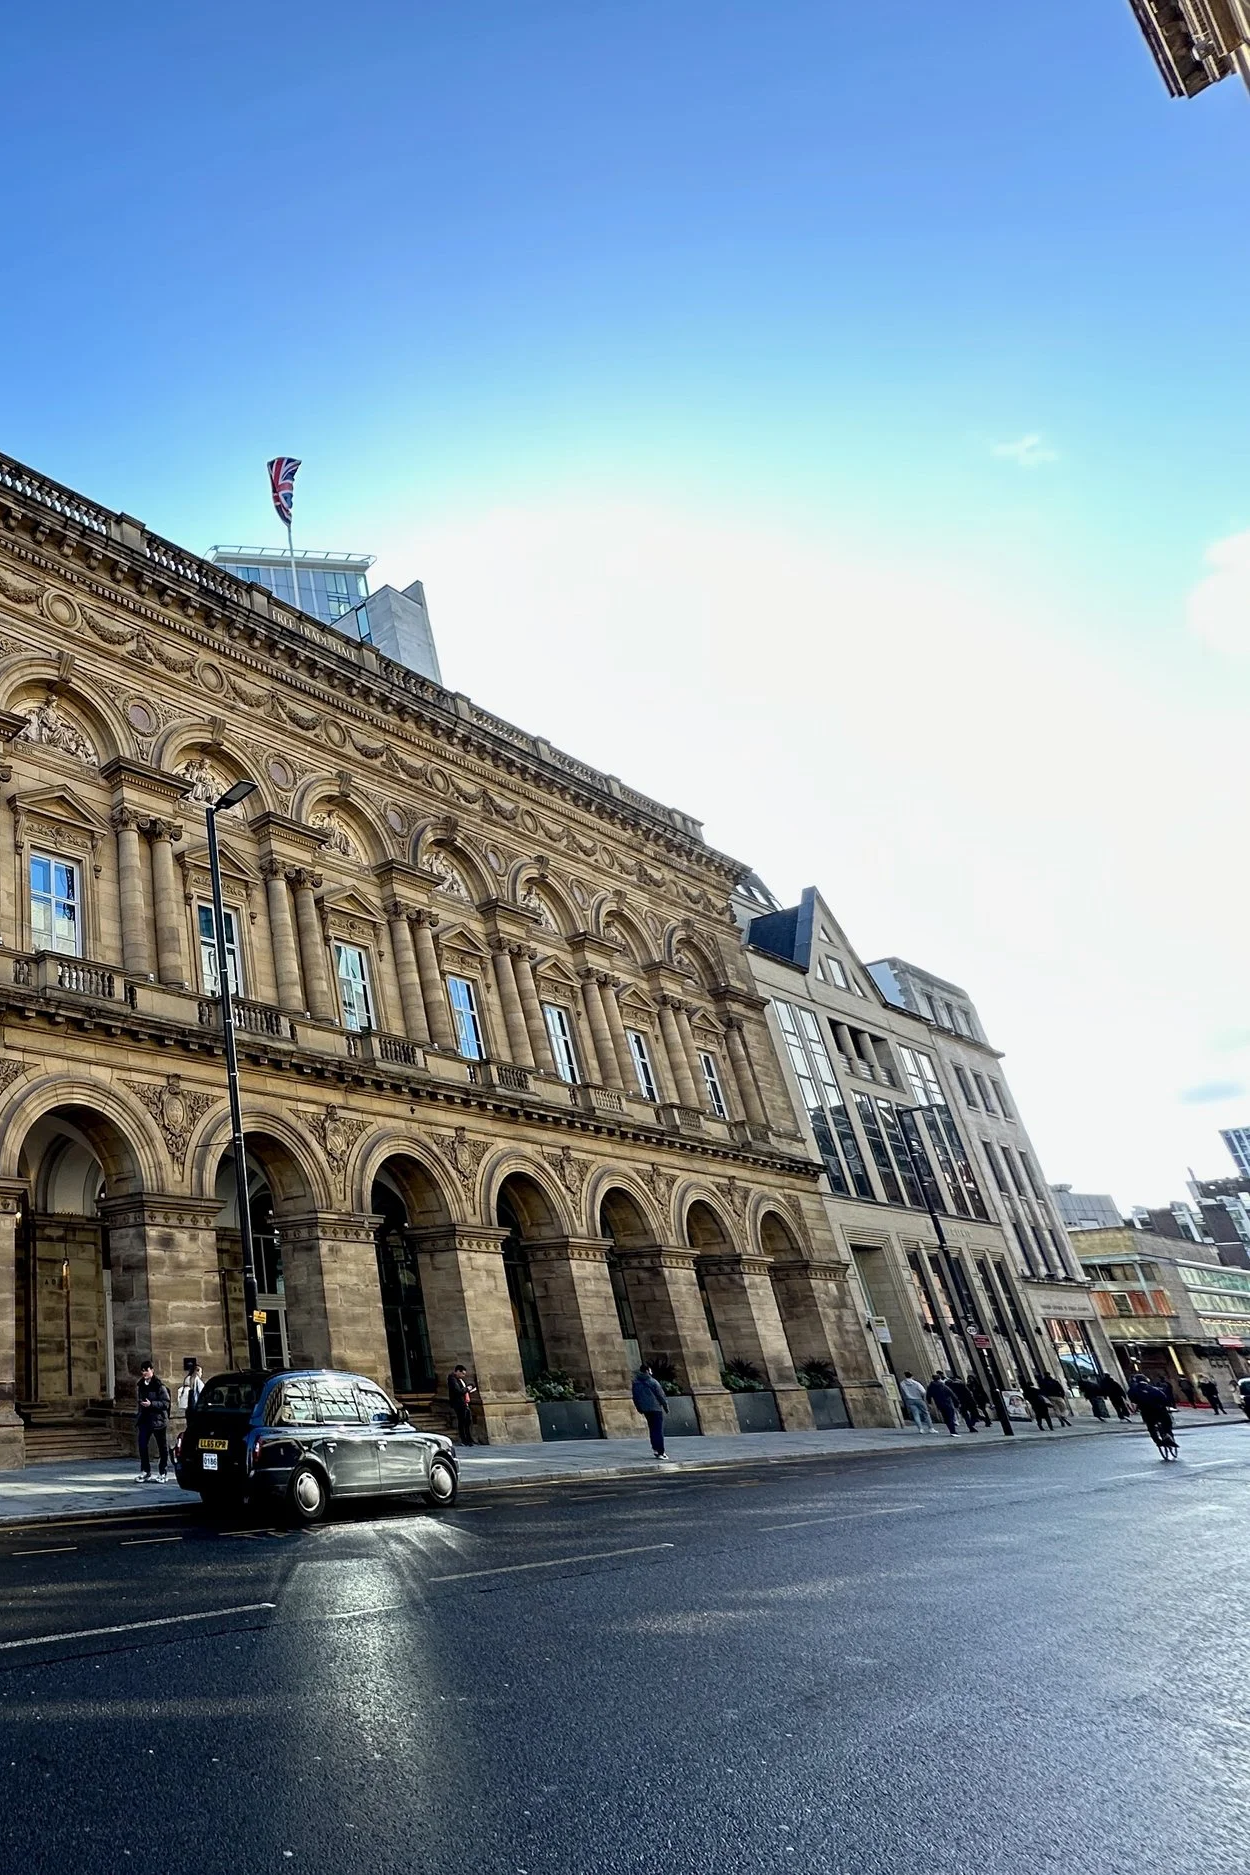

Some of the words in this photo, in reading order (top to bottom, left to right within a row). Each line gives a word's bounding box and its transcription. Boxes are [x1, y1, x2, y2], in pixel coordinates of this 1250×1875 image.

[272, 610, 295, 629] FREE
[300, 625, 330, 648] TRADE
[332, 641, 357, 661] HALL
